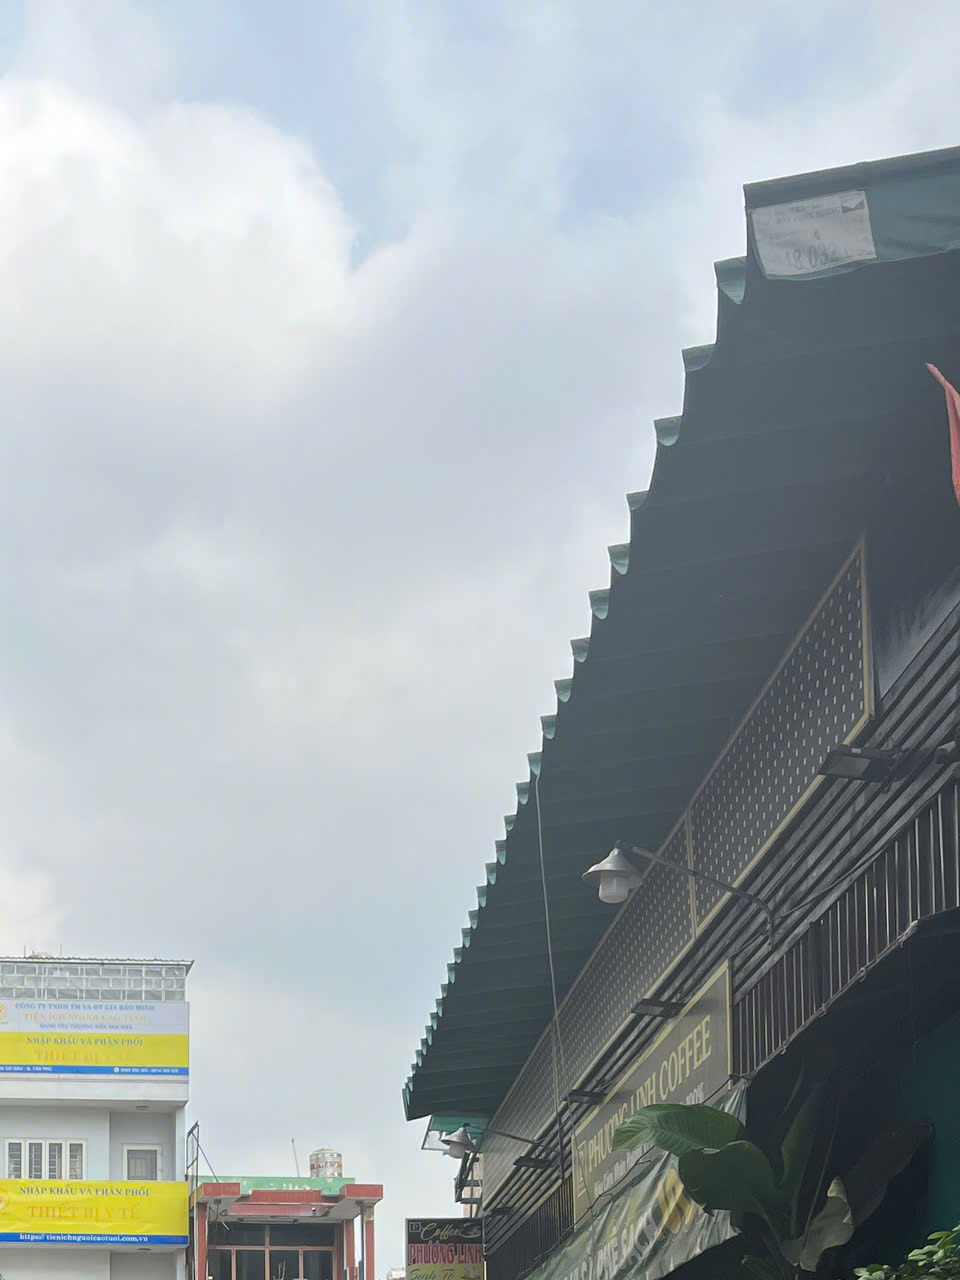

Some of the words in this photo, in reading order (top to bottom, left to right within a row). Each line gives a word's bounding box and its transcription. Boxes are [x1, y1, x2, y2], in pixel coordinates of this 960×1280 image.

[659, 1014, 712, 1100] COFFEE
[19, 1186, 47, 1197] NHẬP
[49, 1186, 77, 1195] KHẨU
[79, 1187, 93, 1196] VÀ
[95, 1187, 122, 1197] PHÂN
[125, 1186, 151, 1197] PHỐI
[420, 1222, 460, 1241] Coffee
[457, 1244, 484, 1265] LINH
